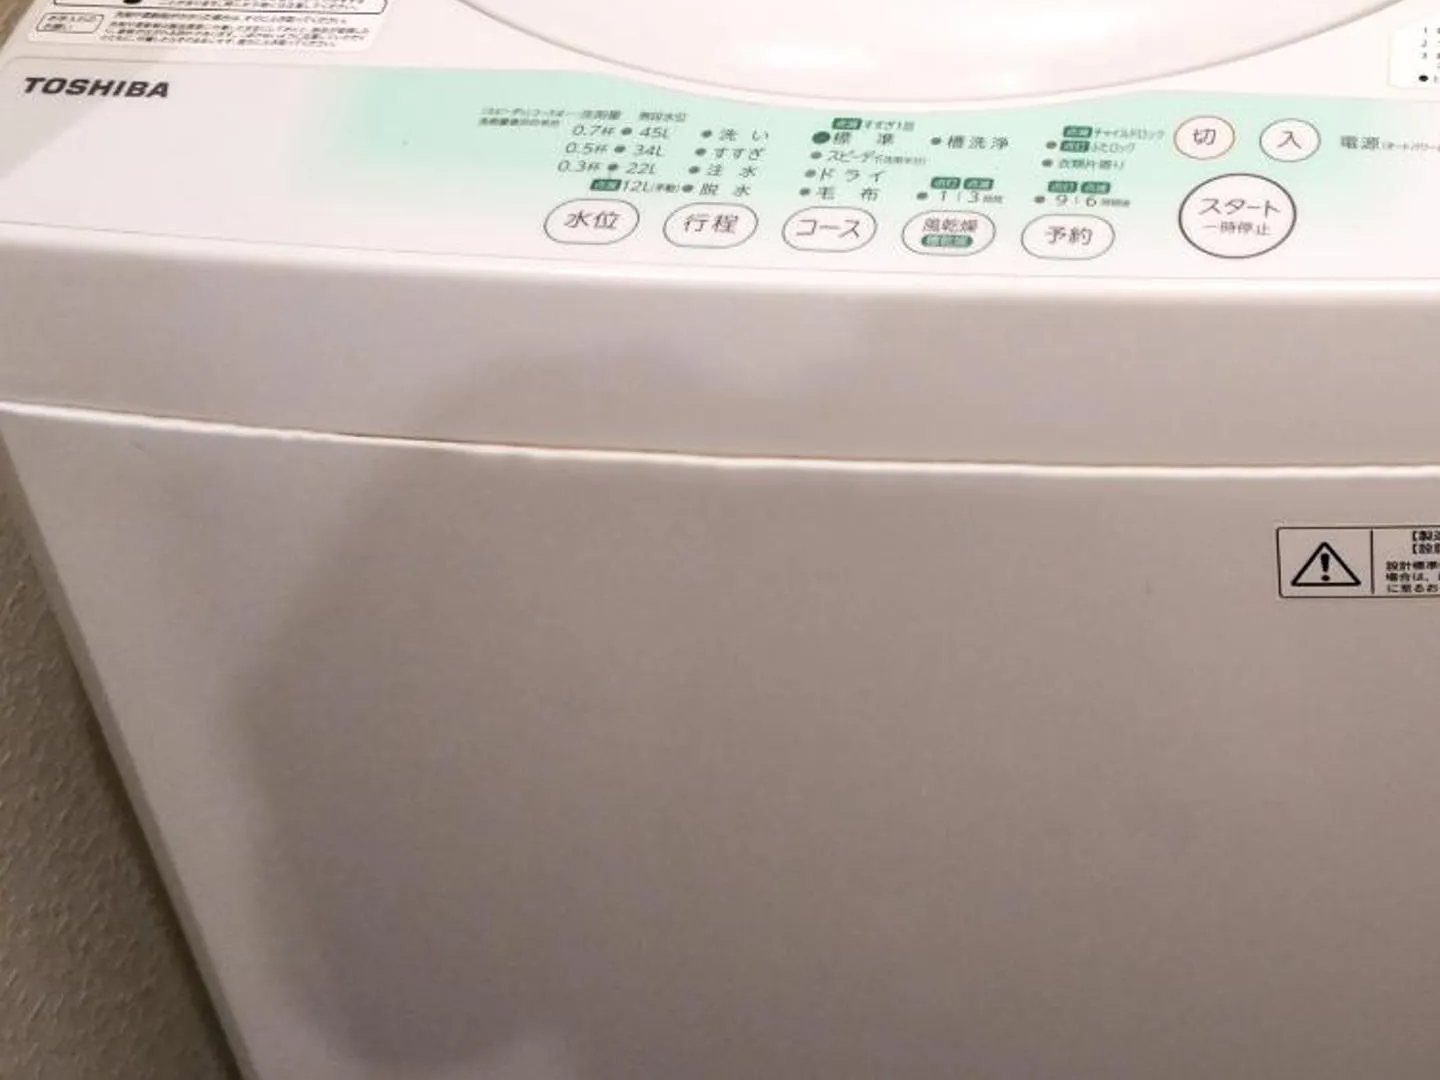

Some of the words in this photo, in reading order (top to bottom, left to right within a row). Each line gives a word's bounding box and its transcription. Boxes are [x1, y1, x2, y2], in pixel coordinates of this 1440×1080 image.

[24, 77, 169, 98] TOSHIBA
[1192, 127, 1216, 147] 切
[1275, 130, 1304, 150] 入
[1198, 196, 1281, 219] スタート
[564, 210, 620, 231] 水位
[683, 213, 740, 235] 行程
[795, 219, 861, 239] コース
[1044, 226, 1094, 245] 予約
